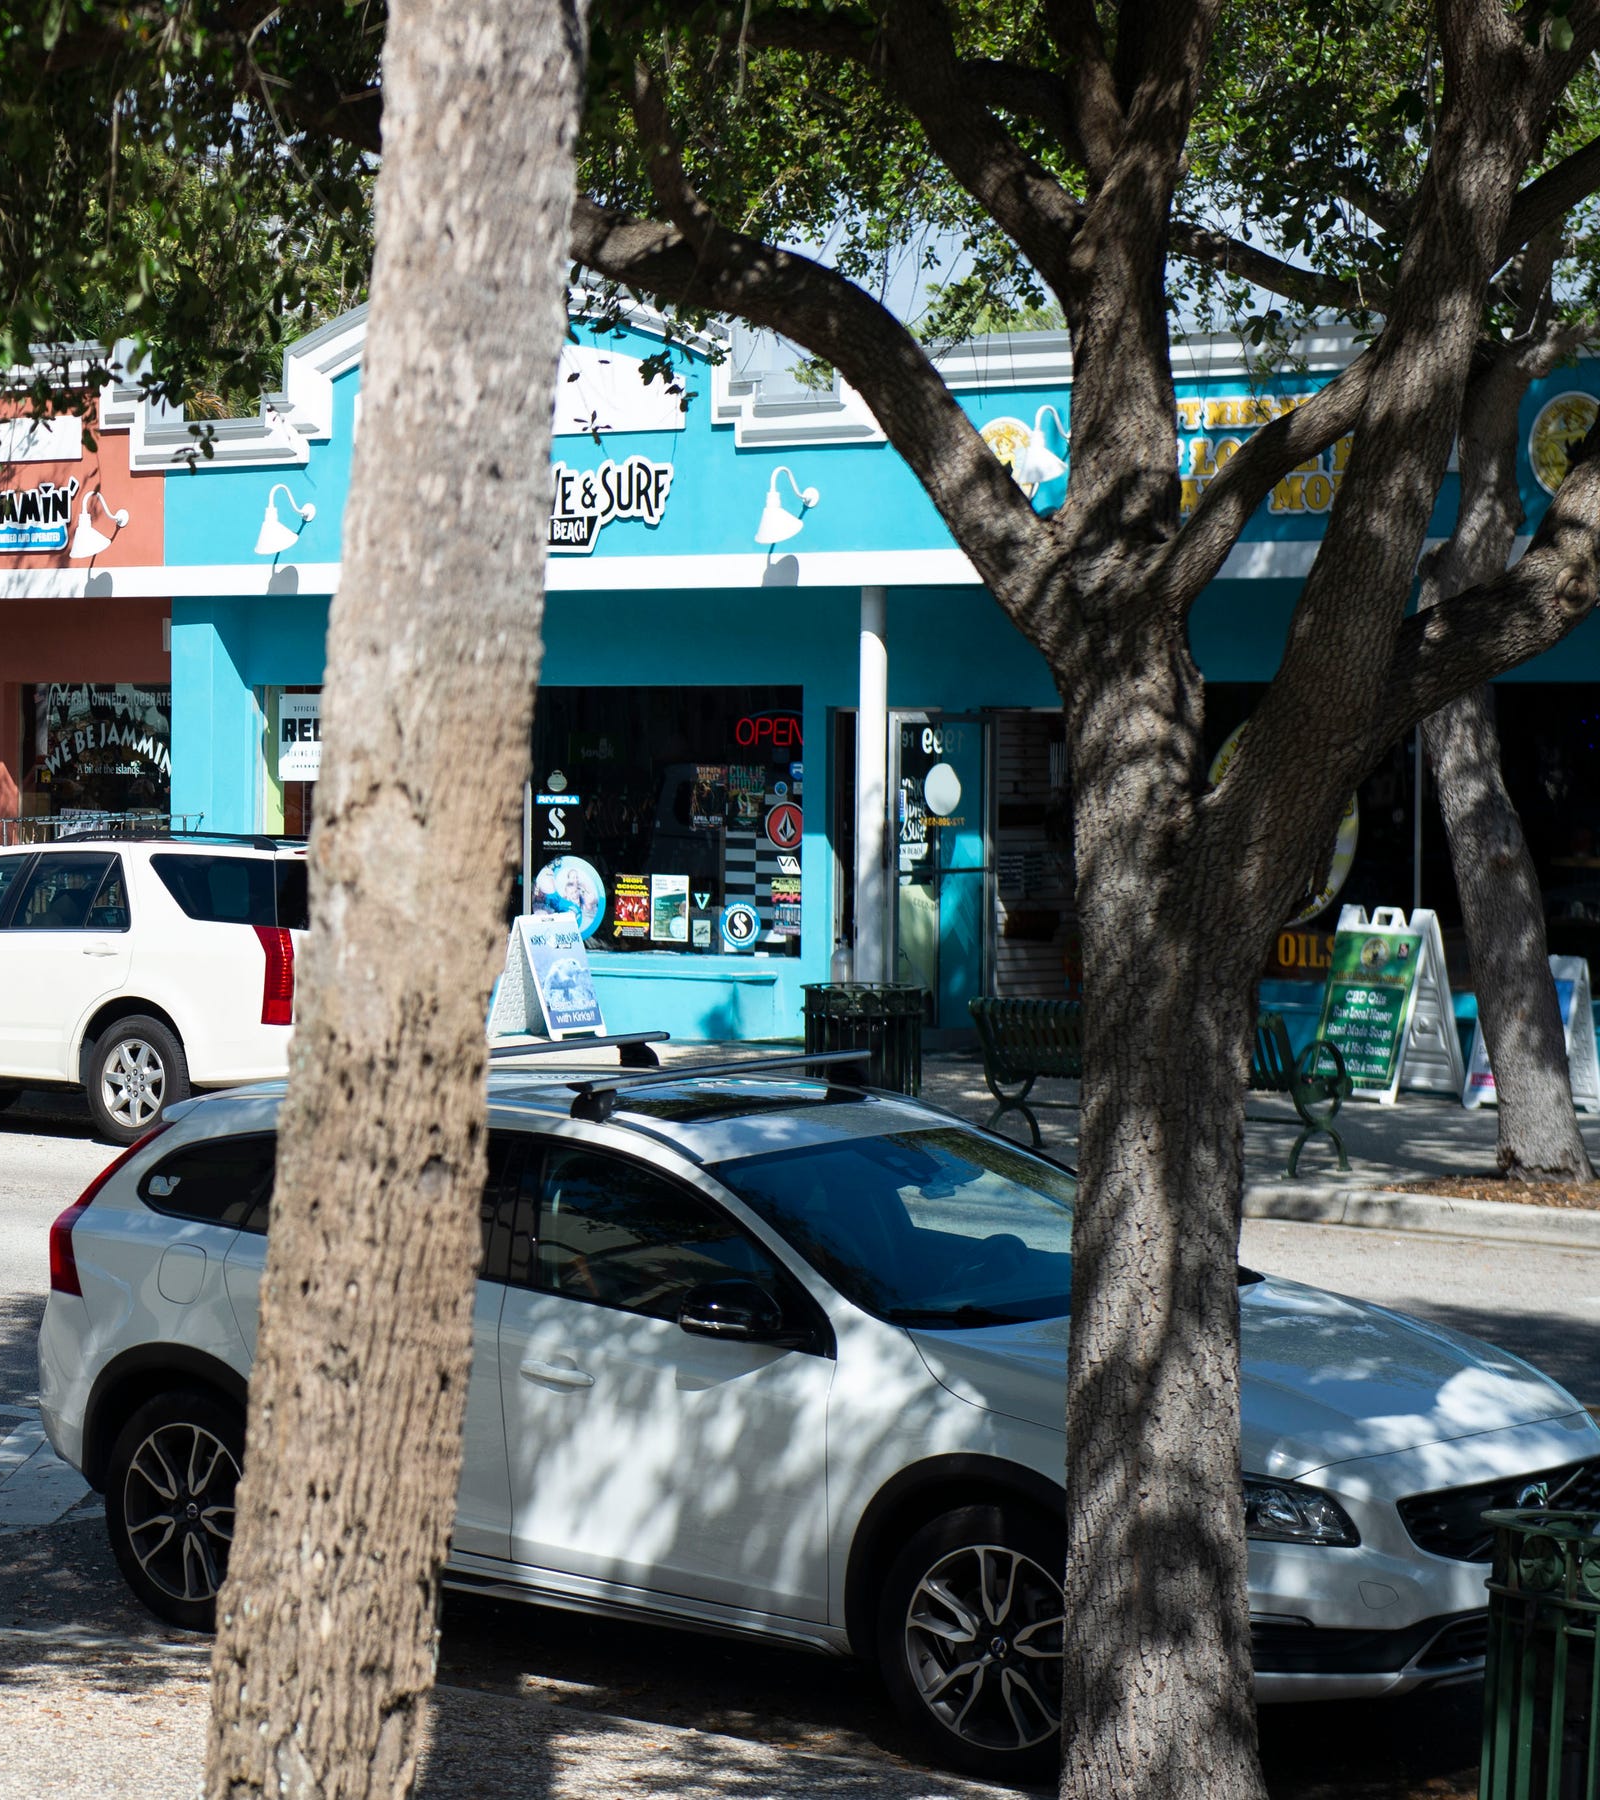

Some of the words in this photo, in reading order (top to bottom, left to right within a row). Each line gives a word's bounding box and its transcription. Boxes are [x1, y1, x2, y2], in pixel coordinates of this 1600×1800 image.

[581, 476, 597, 509] &
[601, 462, 668, 517] SURF
[18, 533, 30, 543] AND
[31, 532, 60, 543] OPERATED
[553, 519, 588, 542] BEACH
[92, 692, 121, 706] OWNED
[735, 717, 804, 746] OPEN
[45, 739, 72, 776] WE
[74, 724, 96, 754] BE
[615, 889, 649, 897] MUSICAL
[1345, 990, 1367, 1004] CBD
[556, 1012, 572, 1023] with
[1370, 1008, 1393, 1024] Honey
[1327, 1023, 1347, 1036] Hand
